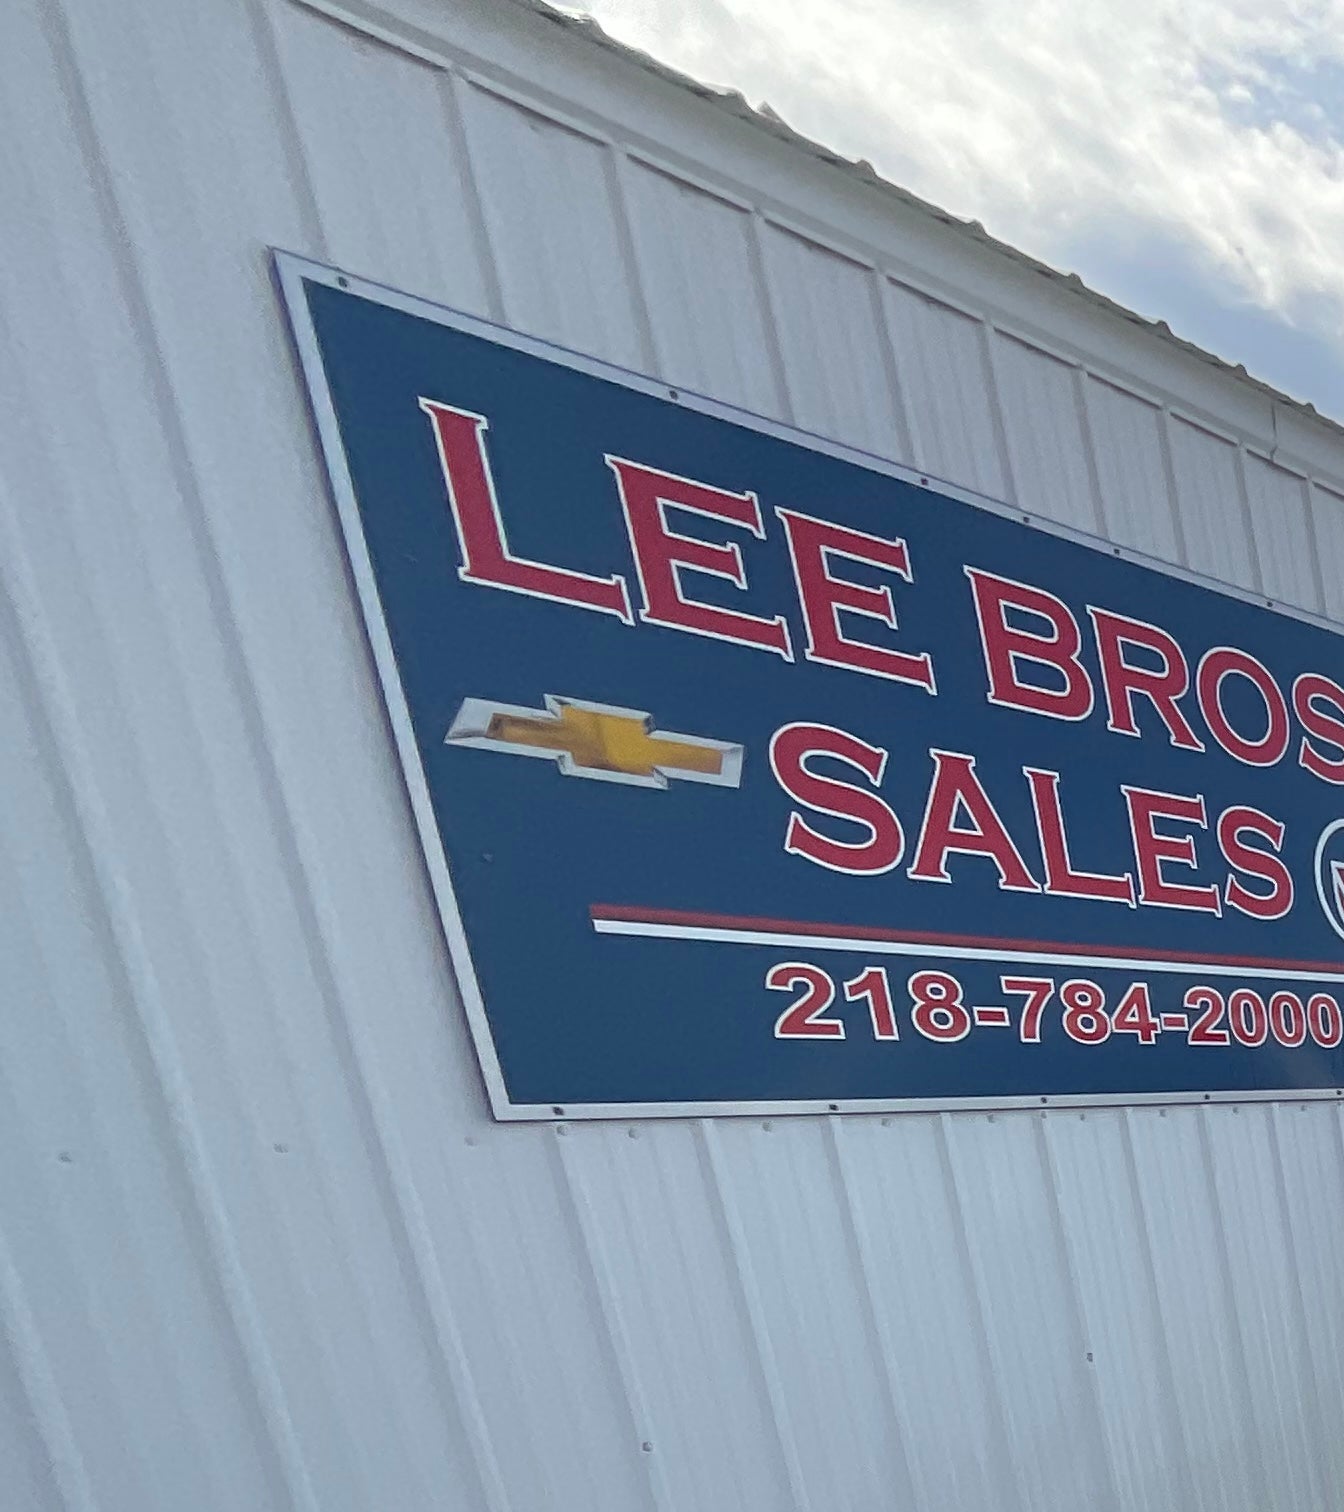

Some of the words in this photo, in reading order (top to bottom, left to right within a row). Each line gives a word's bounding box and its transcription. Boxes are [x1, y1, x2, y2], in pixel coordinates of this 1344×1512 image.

[418, 397, 937, 695] LEE
[768, 722, 1294, 919] SALES
[766, 962, 1343, 1048] 218-784-2000
